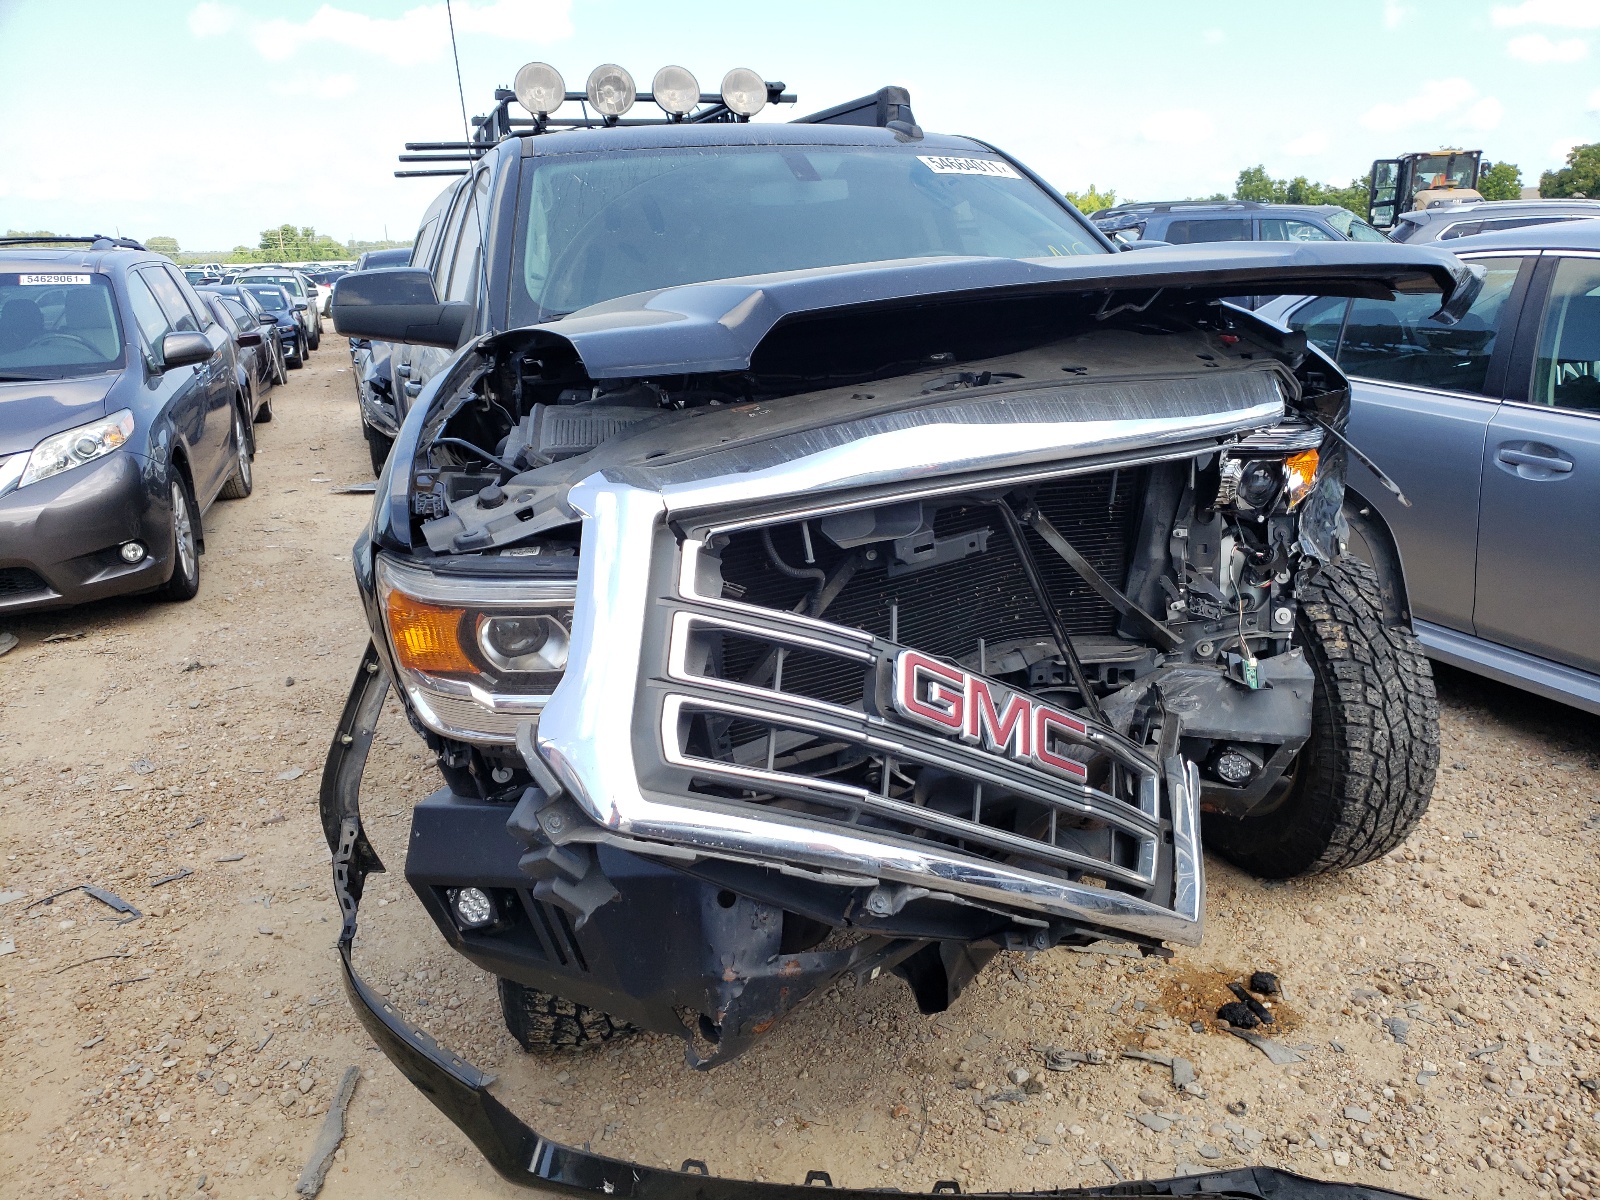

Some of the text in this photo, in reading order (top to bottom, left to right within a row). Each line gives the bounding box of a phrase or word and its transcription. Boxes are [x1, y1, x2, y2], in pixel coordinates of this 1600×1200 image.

[927, 157, 1003, 173] 54664011
[27, 275, 79, 283] 54629061
[893, 650, 1088, 784] GMC
